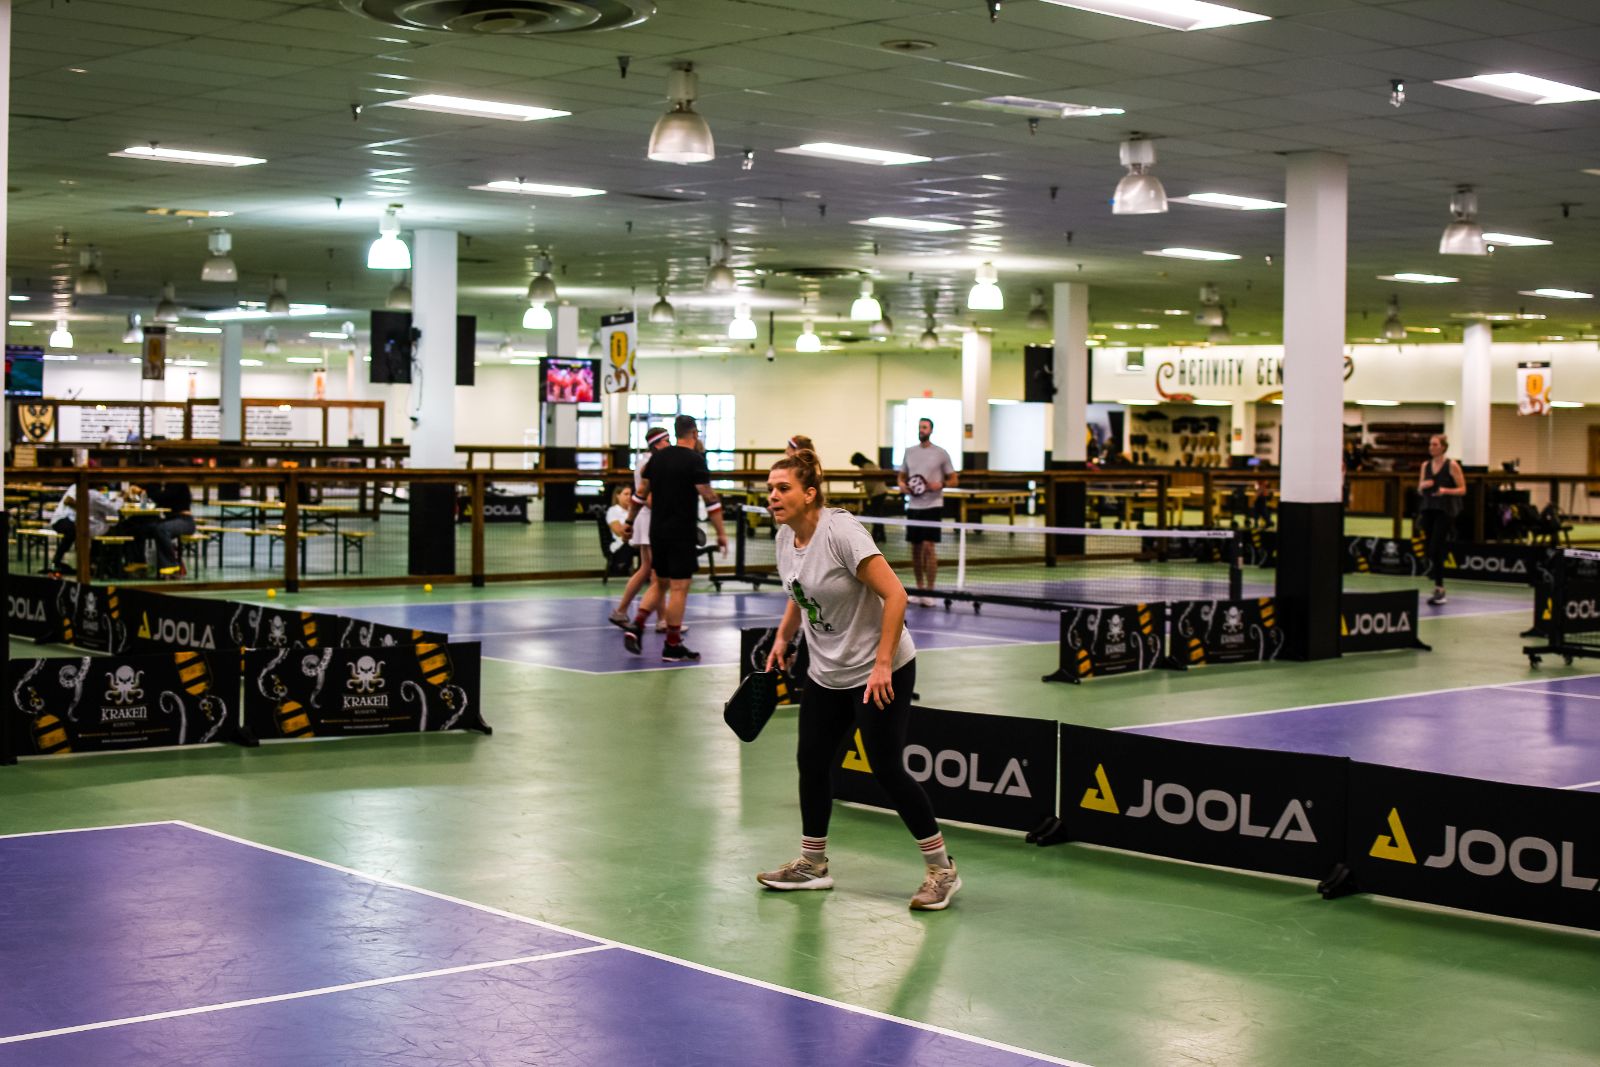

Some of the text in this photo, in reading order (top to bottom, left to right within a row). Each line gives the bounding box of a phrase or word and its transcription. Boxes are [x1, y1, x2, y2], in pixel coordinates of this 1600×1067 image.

[1178, 358, 1244, 386] ACTIVITY
[1460, 556, 1527, 573] JOOLA
[153, 617, 216, 650] JOOLA
[1349, 611, 1411, 636] JOOLA
[101, 706, 148, 721] KRAKEN
[342, 695, 389, 709] KRAKEN
[902, 744, 1033, 798] OOLA
[1125, 779, 1319, 843] JOOLA
[1423, 825, 1600, 891] JOOL
